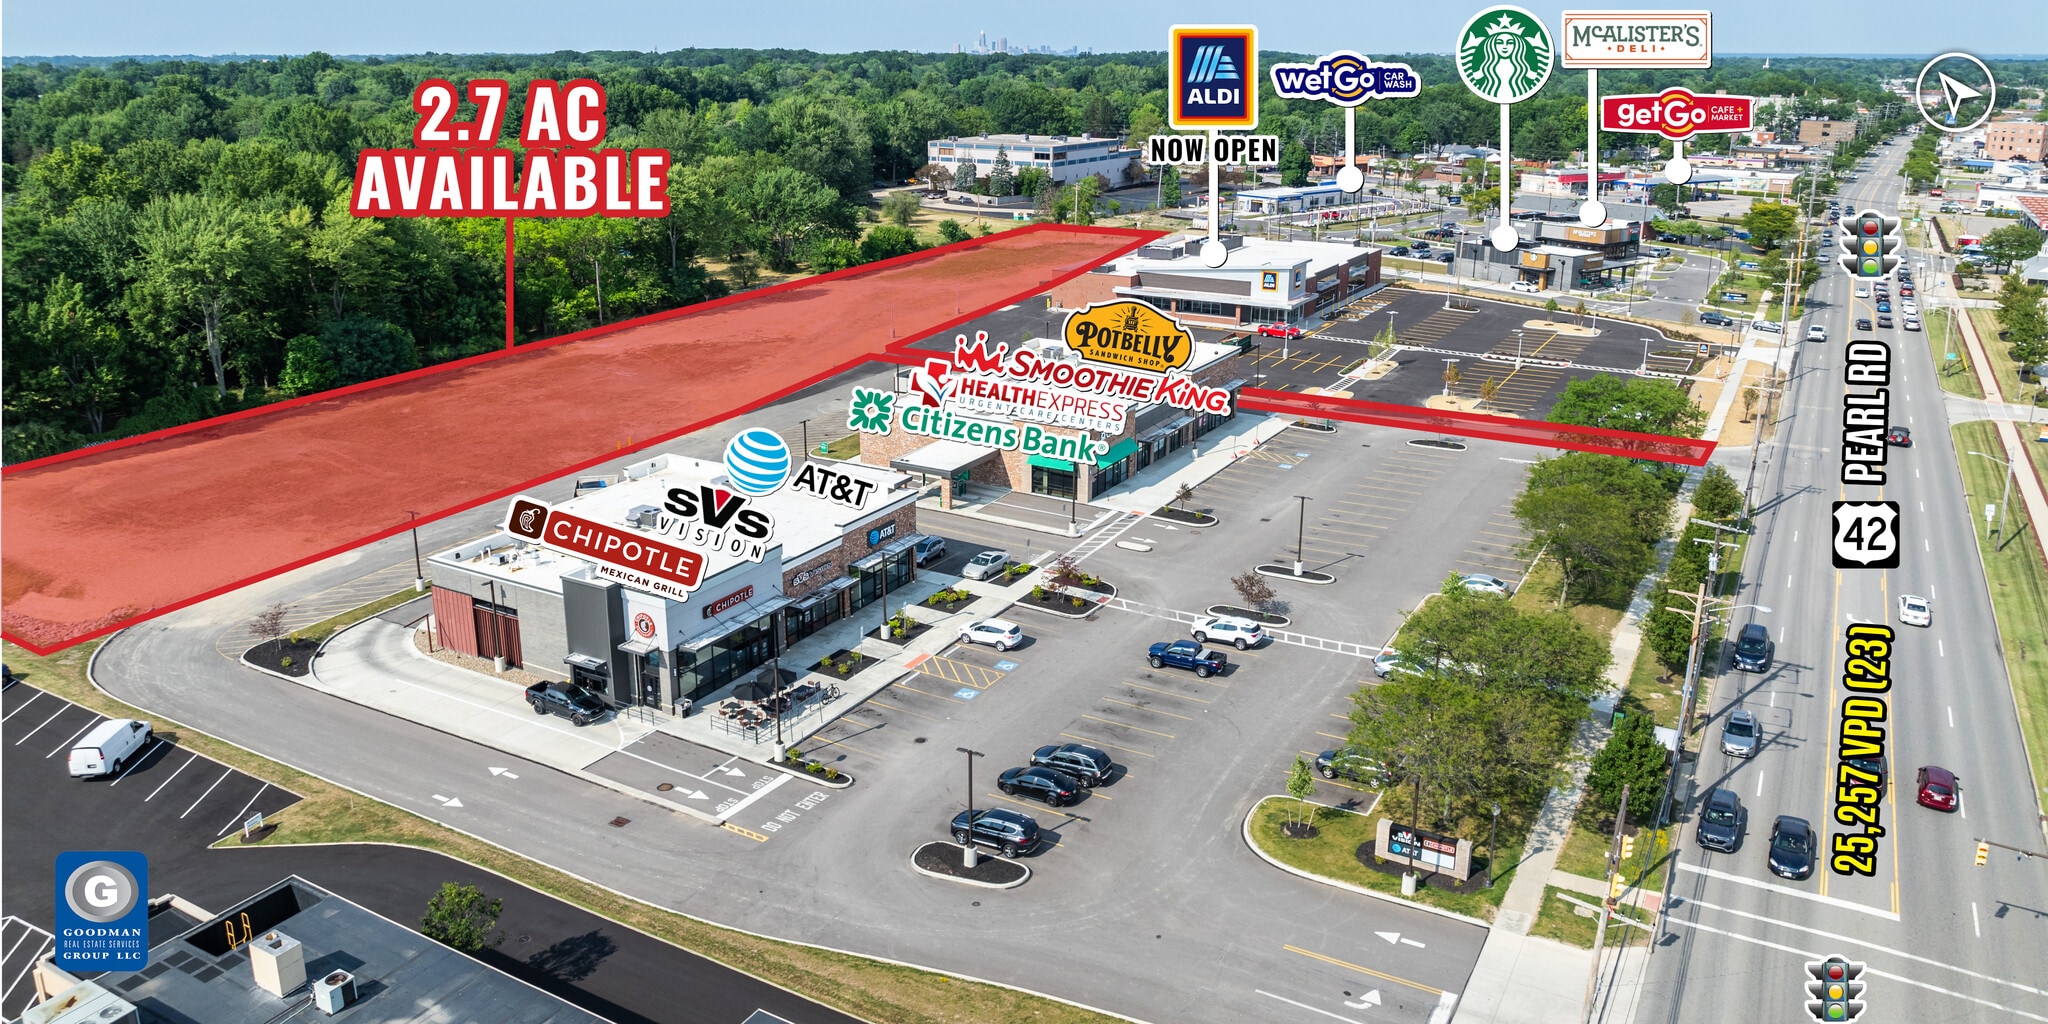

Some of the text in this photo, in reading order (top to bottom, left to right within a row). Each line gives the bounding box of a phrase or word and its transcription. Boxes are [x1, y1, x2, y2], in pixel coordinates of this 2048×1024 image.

[880, 524, 896, 540] AT&T
[715, 588, 753, 612] CHIPOTLE
[751, 775, 774, 790] STOP
[714, 797, 739, 813] STOP
[760, 791, 830, 832] DO NOT ENTER
[1401, 847, 1419, 857] ATT
